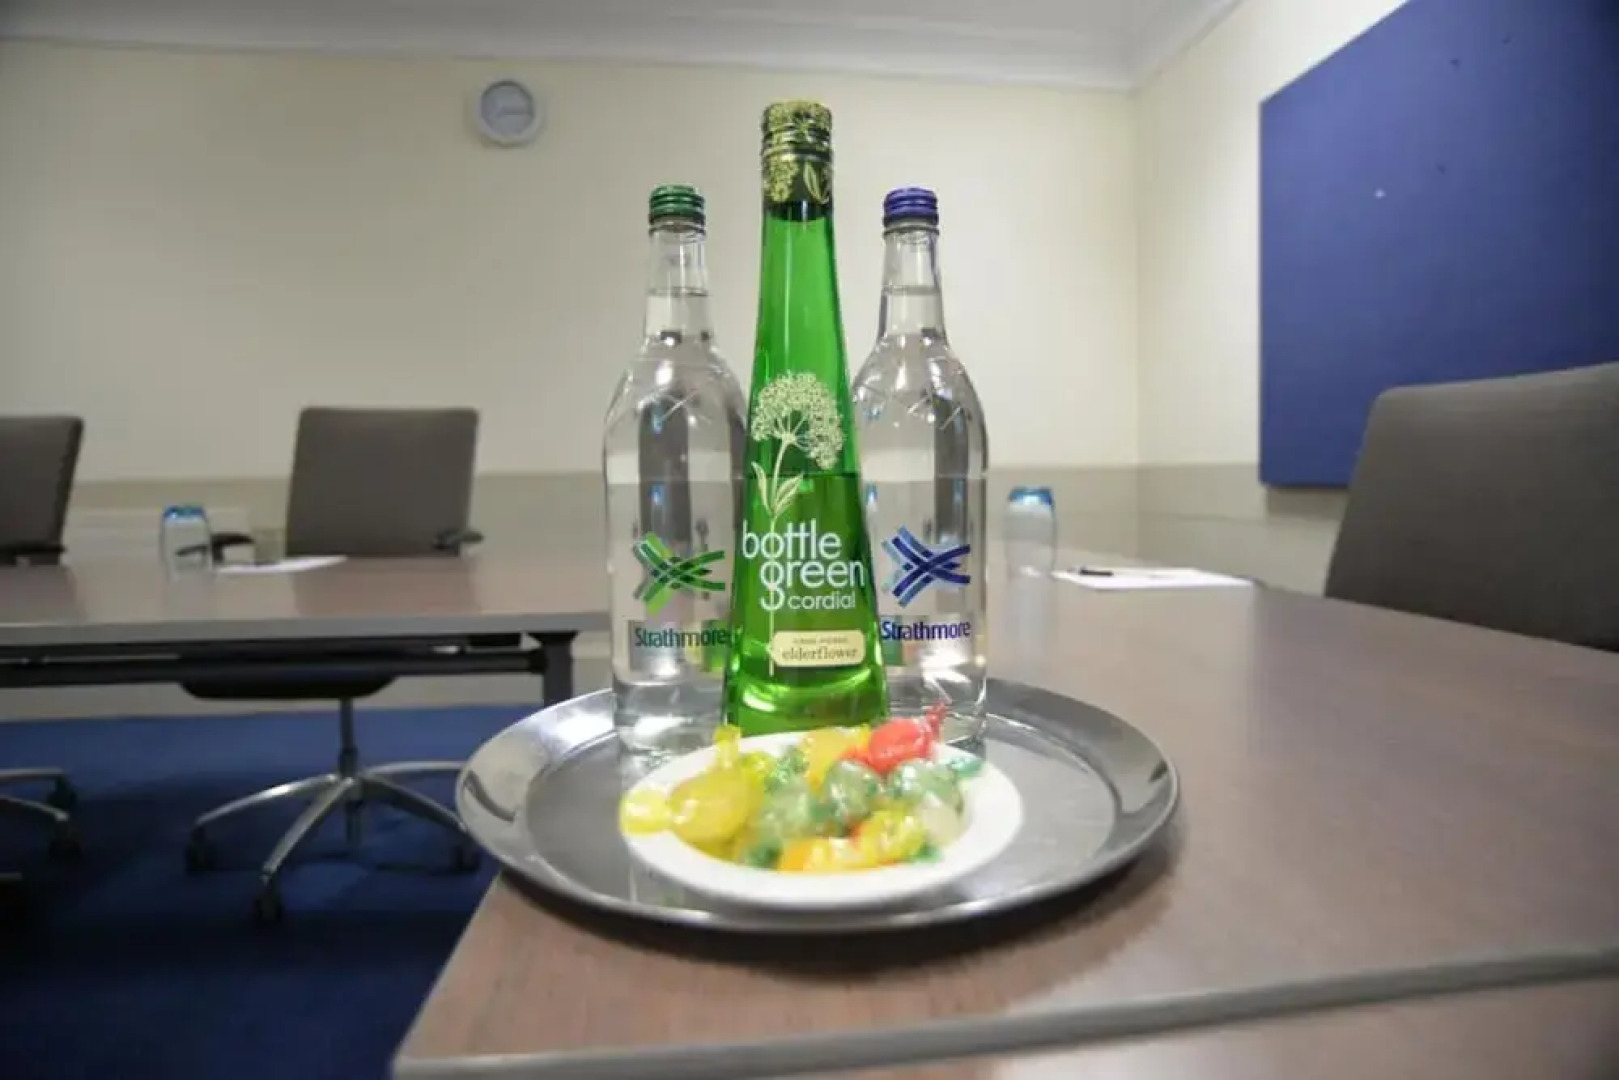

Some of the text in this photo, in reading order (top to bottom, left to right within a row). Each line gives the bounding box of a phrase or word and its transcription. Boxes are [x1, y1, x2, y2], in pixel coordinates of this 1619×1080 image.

[742, 518, 842, 560] bottle
[760, 559, 866, 611] green
[787, 590, 856, 610] cordial
[634, 627, 728, 647] Strathmore
[881, 620, 971, 641] Strathmore
[782, 646, 859, 661] elderflower
